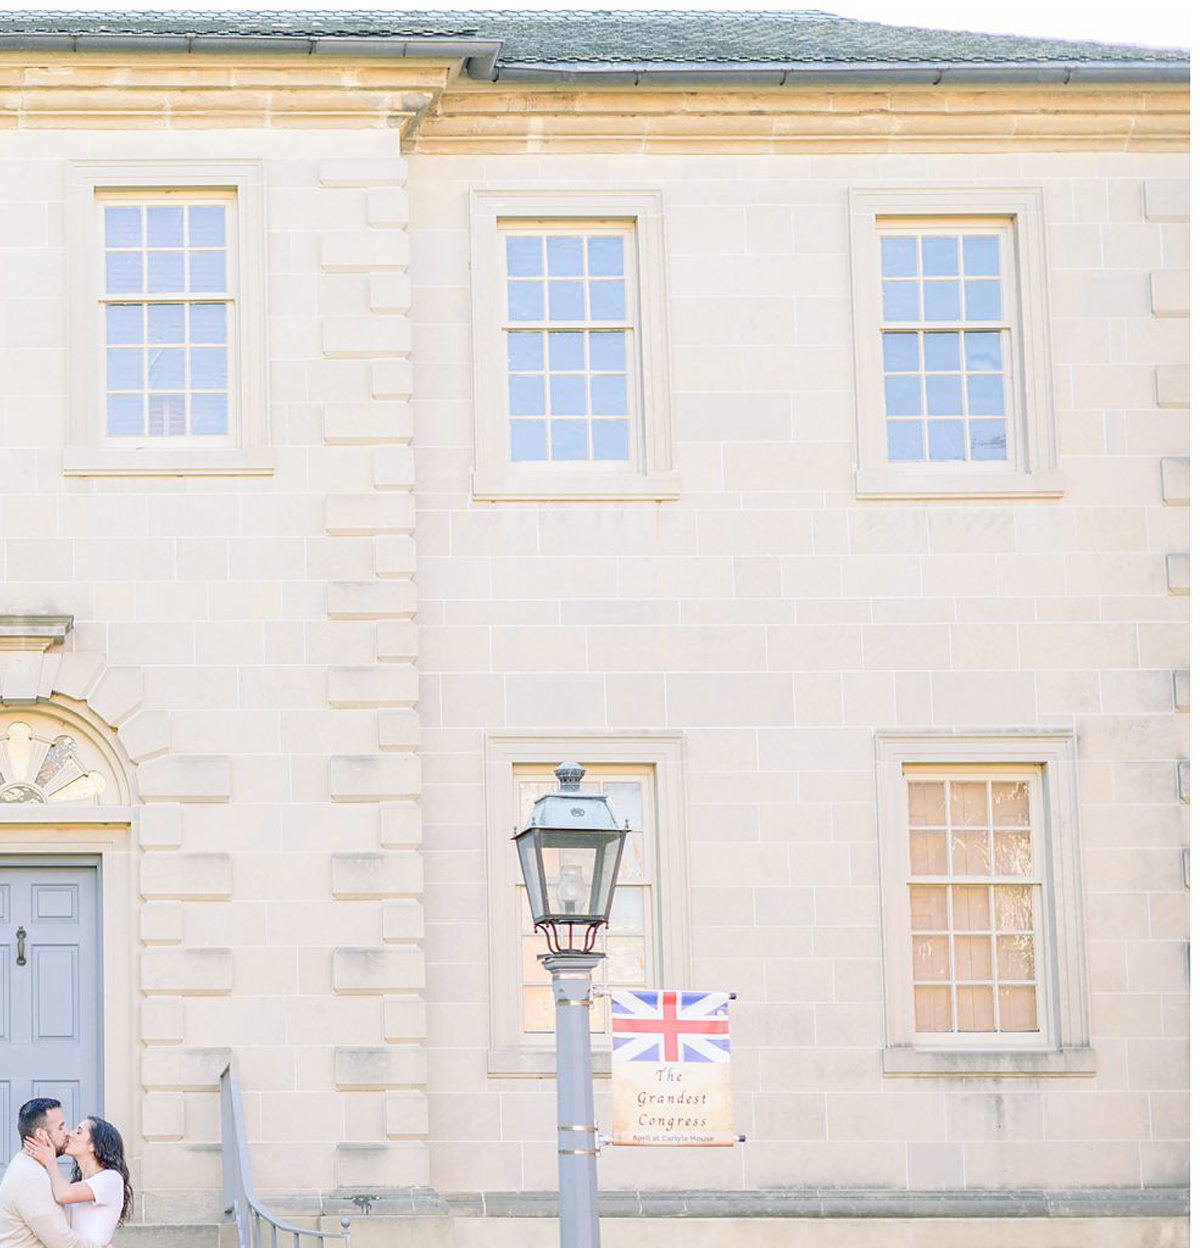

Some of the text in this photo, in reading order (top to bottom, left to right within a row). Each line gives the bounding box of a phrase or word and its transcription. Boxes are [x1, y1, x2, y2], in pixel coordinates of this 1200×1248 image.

[656, 1067, 683, 1082] The
[637, 1090, 706, 1107] Grandest
[638, 1113, 707, 1131] Congress
[661, 1135, 689, 1143] Carlyle
[690, 1134, 715, 1142] House
